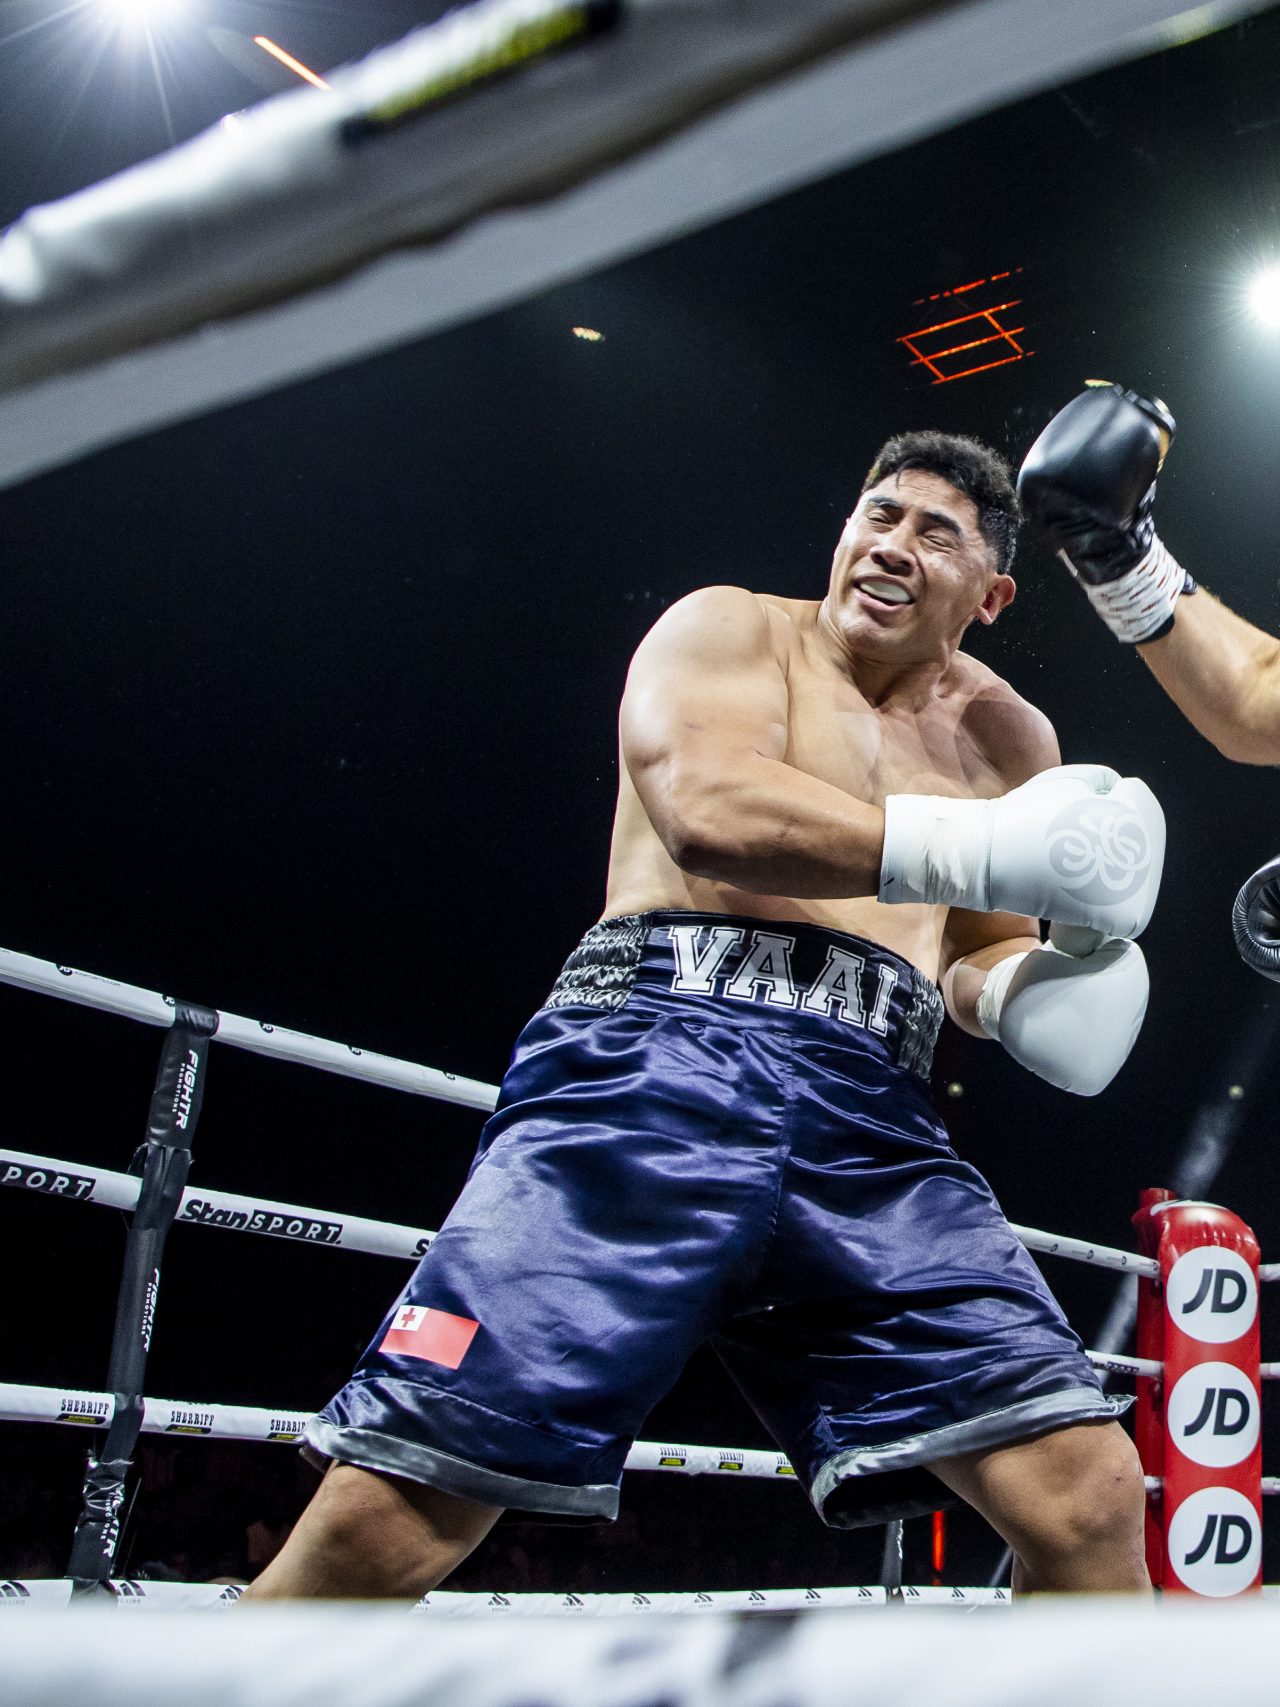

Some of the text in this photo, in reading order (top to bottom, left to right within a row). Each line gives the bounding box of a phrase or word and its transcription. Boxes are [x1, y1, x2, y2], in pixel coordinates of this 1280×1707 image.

[667, 926, 899, 1038] VAAI
[172, 1062, 186, 1113] PROMOTIONS
[176, 1049, 199, 1130] FIGHTR
[1182, 1268, 1248, 1314] JD
[61, 1399, 306, 1433] SHERRIFF SHERRIFF SHERRIF
[1184, 1388, 1251, 1437] JD
[1185, 1513, 1252, 1565] JD
